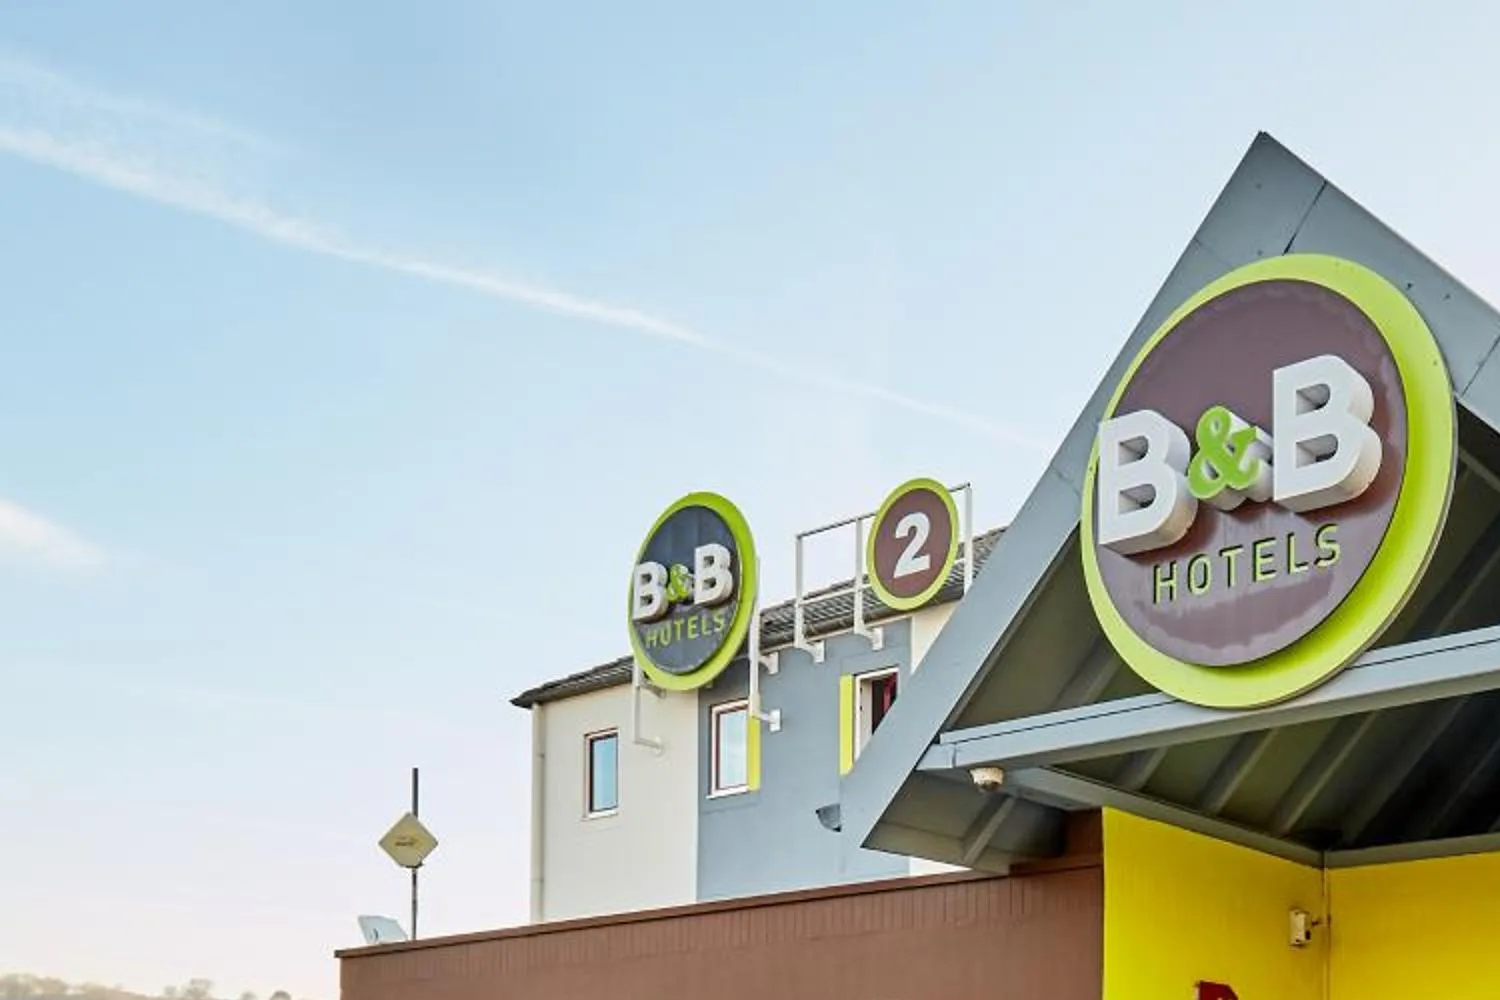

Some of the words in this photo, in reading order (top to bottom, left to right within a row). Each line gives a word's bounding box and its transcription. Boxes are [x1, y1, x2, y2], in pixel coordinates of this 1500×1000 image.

[1098, 354, 1383, 555] B&B
[632, 543, 734, 624] B&B
[893, 512, 931, 579] 2
[1152, 523, 1343, 604] HOTELS
[645, 611, 726, 649] HOTELS
